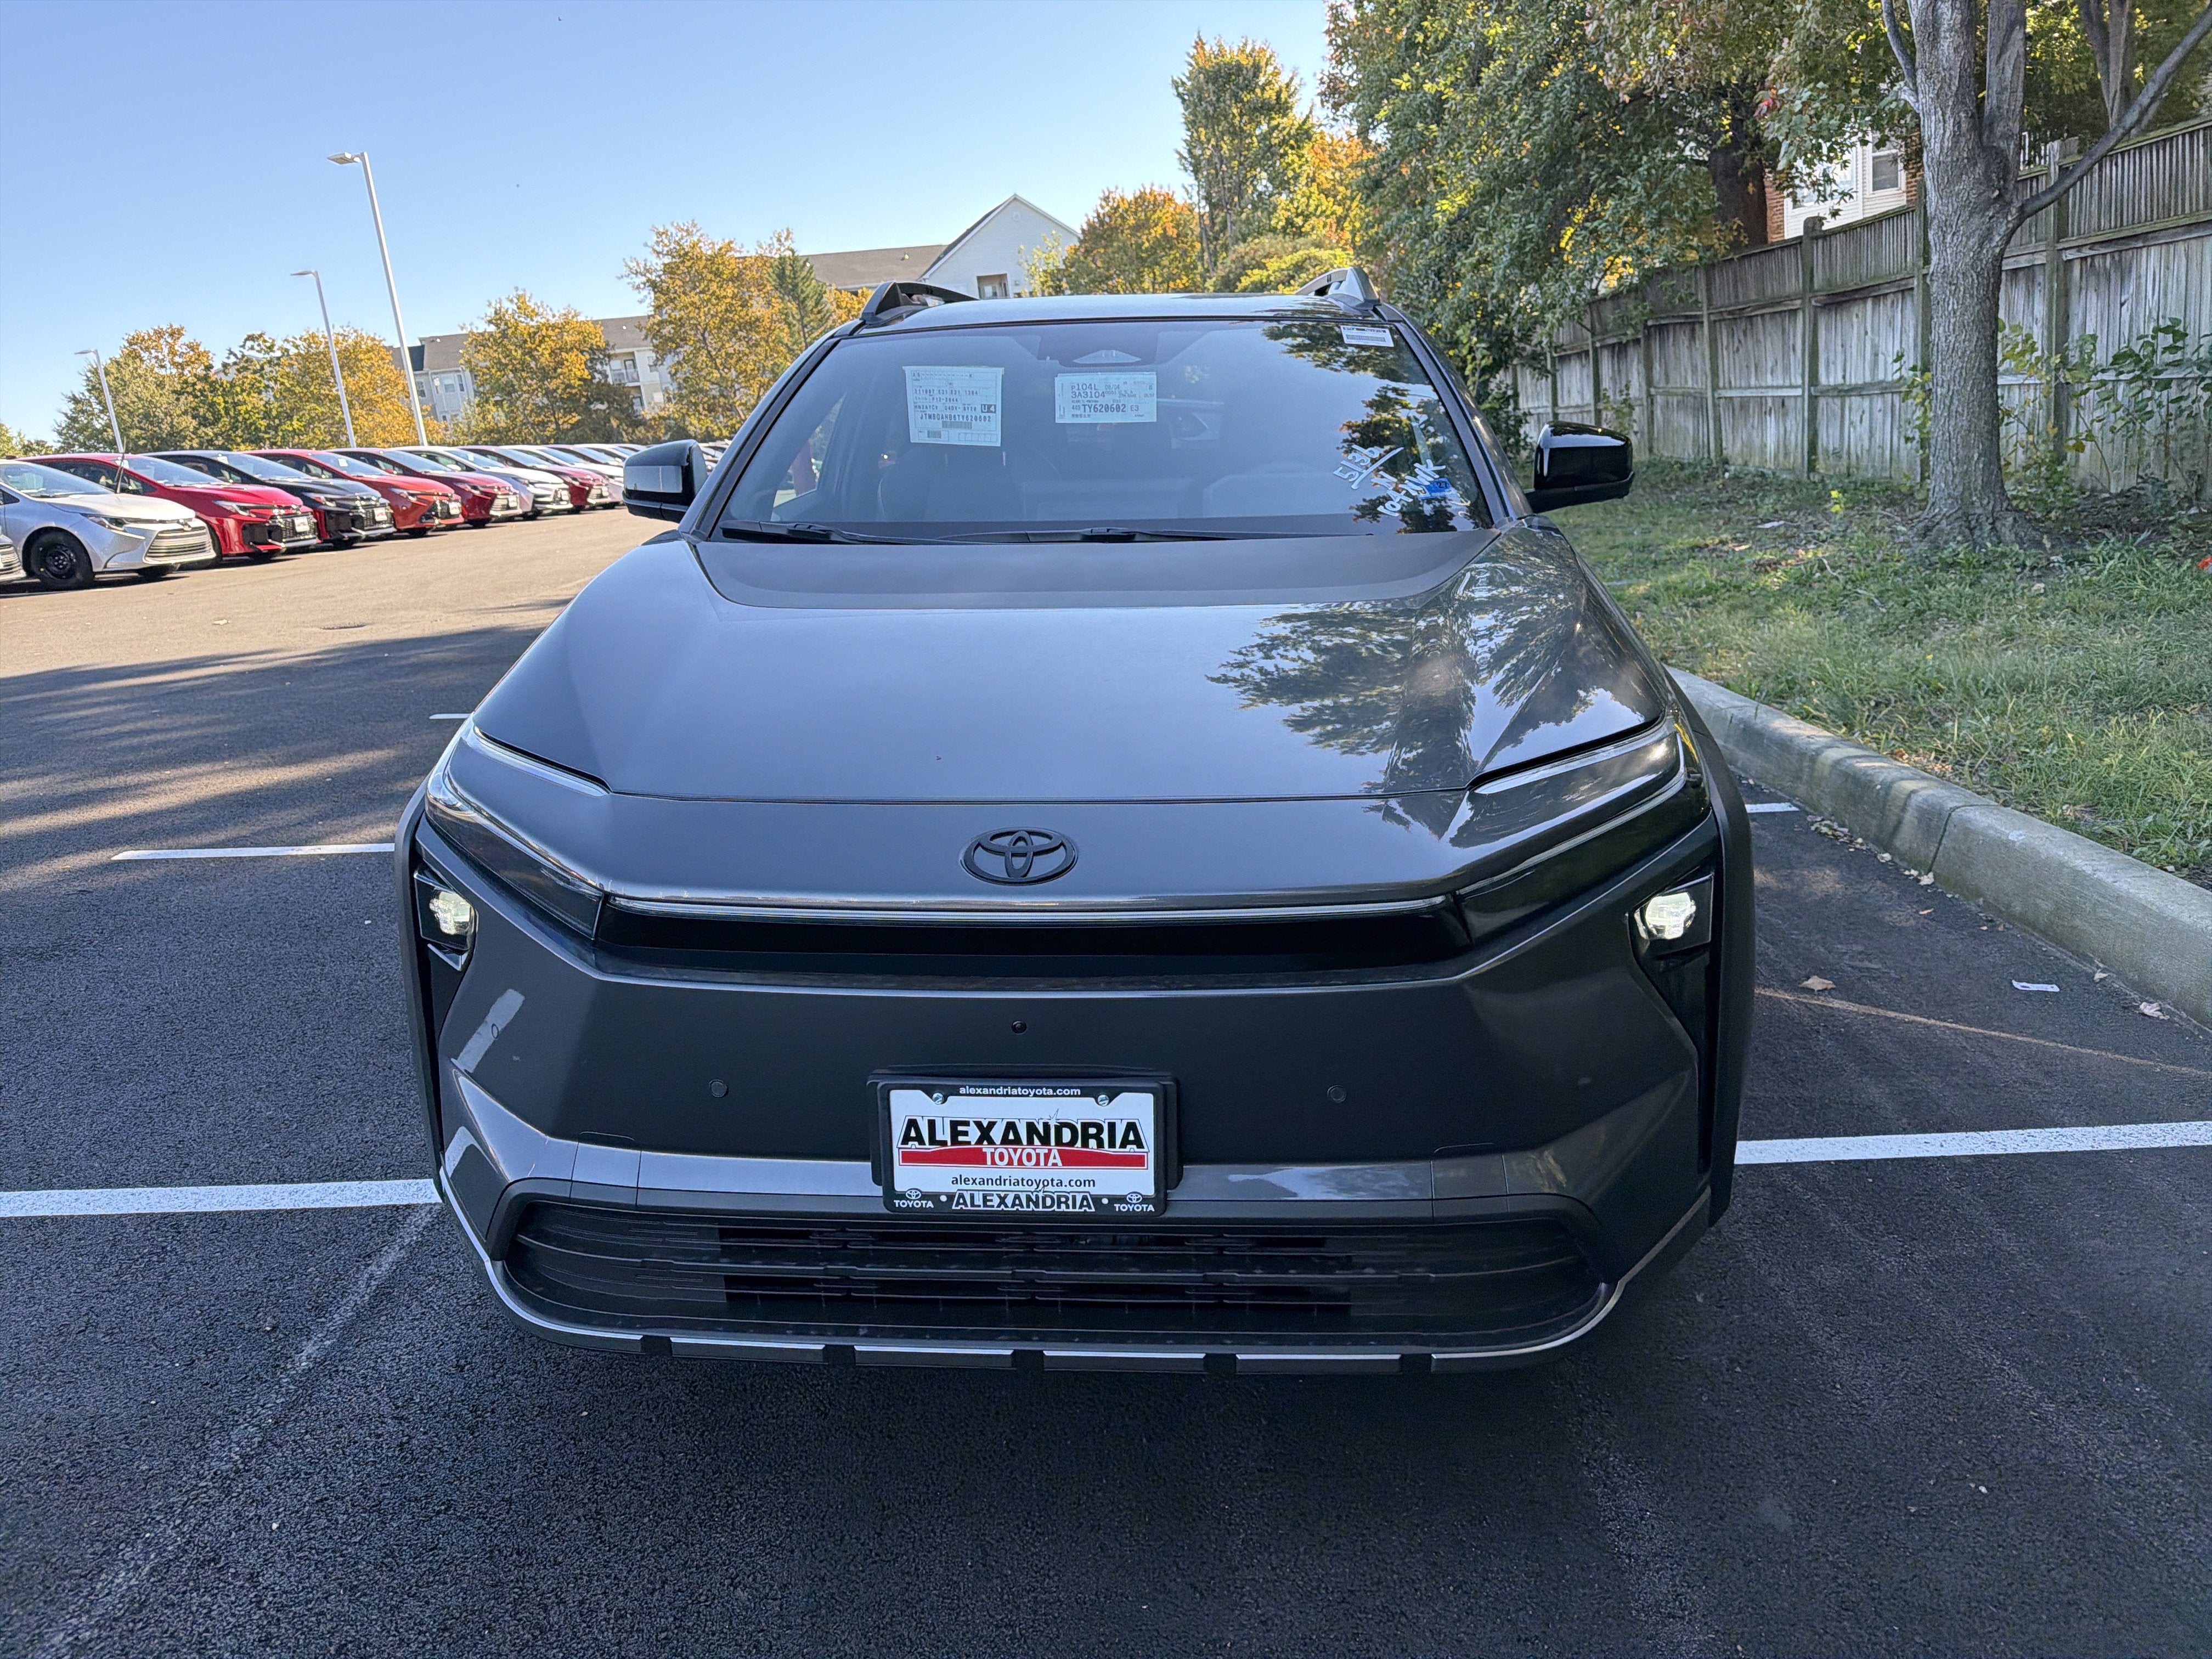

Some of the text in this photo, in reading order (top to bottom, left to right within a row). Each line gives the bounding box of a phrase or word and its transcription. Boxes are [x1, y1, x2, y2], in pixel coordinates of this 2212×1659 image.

[1082, 404, 1126, 413] TY620602
[959, 1085, 1081, 1096] alexandriatoyota.com
[899, 1117, 1147, 1150] ALEXANDRIA
[983, 1148, 1063, 1167] TOYOTA
[951, 1174, 1096, 1190] alexandriatoyota.com
[893, 1190, 1155, 1212] TOYOTA ALEXANDRIA TOYOTA
